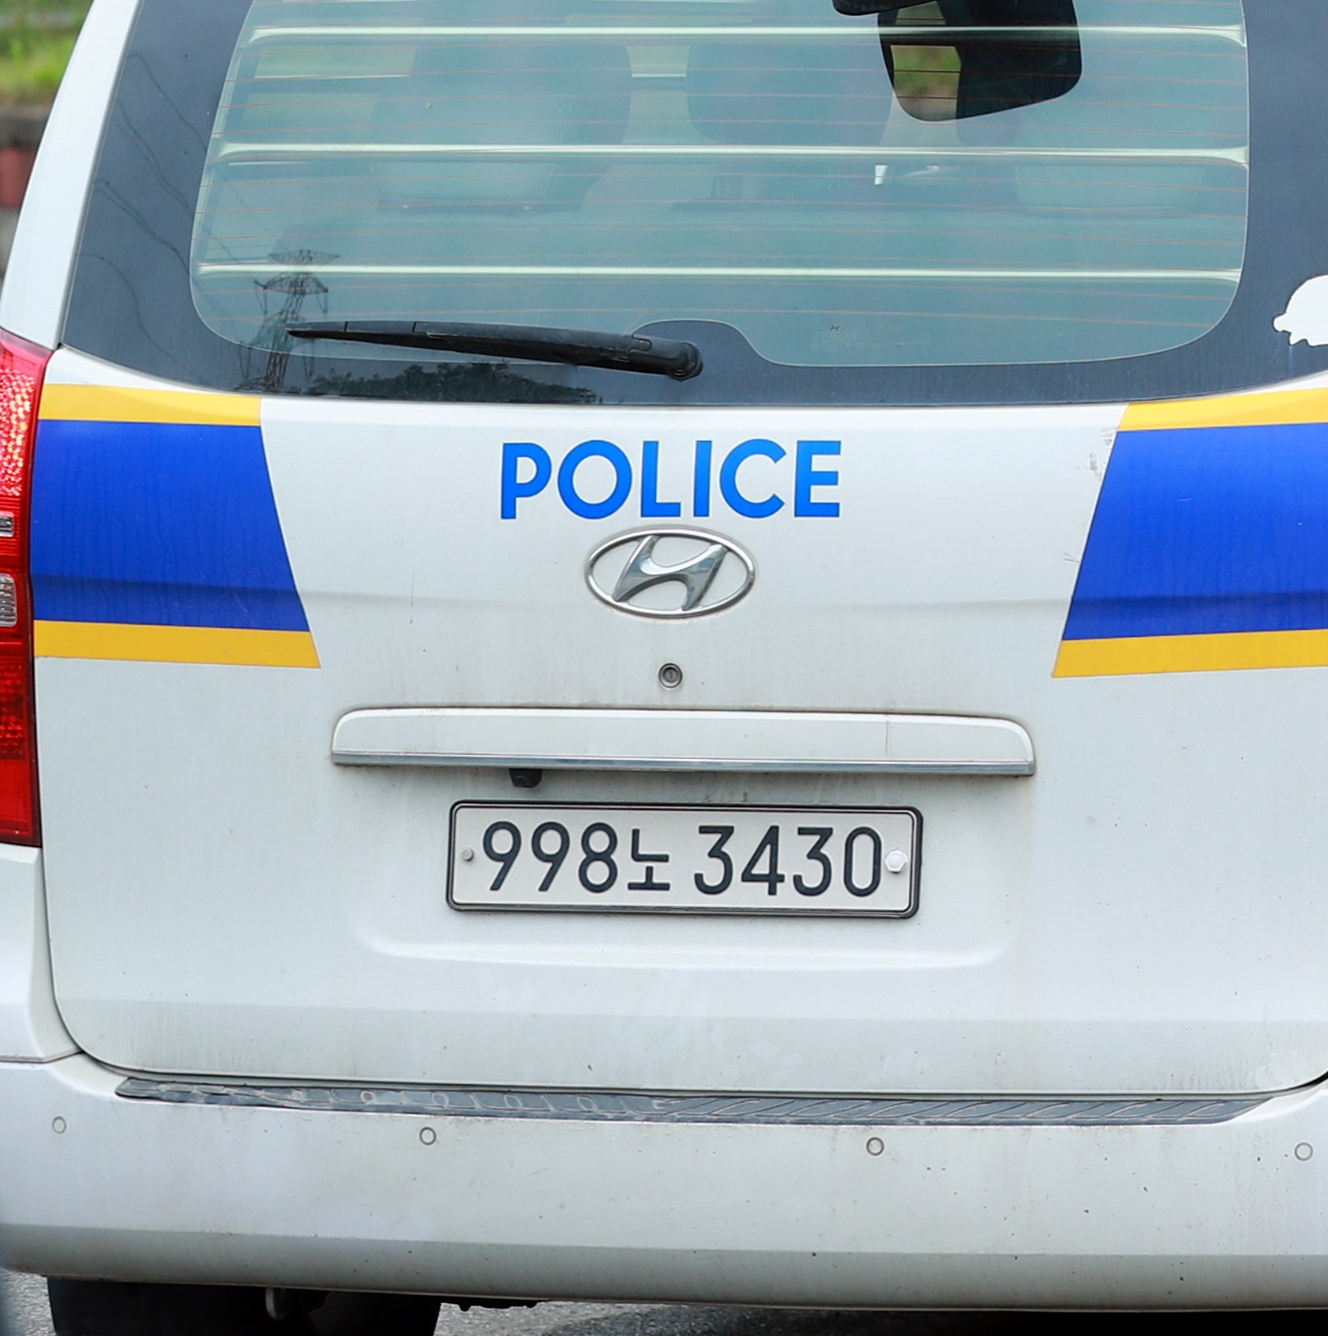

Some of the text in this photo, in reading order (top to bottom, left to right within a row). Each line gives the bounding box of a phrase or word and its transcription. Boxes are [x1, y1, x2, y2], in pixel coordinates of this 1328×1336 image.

[500, 438, 842, 520] POLICE
[482, 820, 883, 897] 998노 3430
